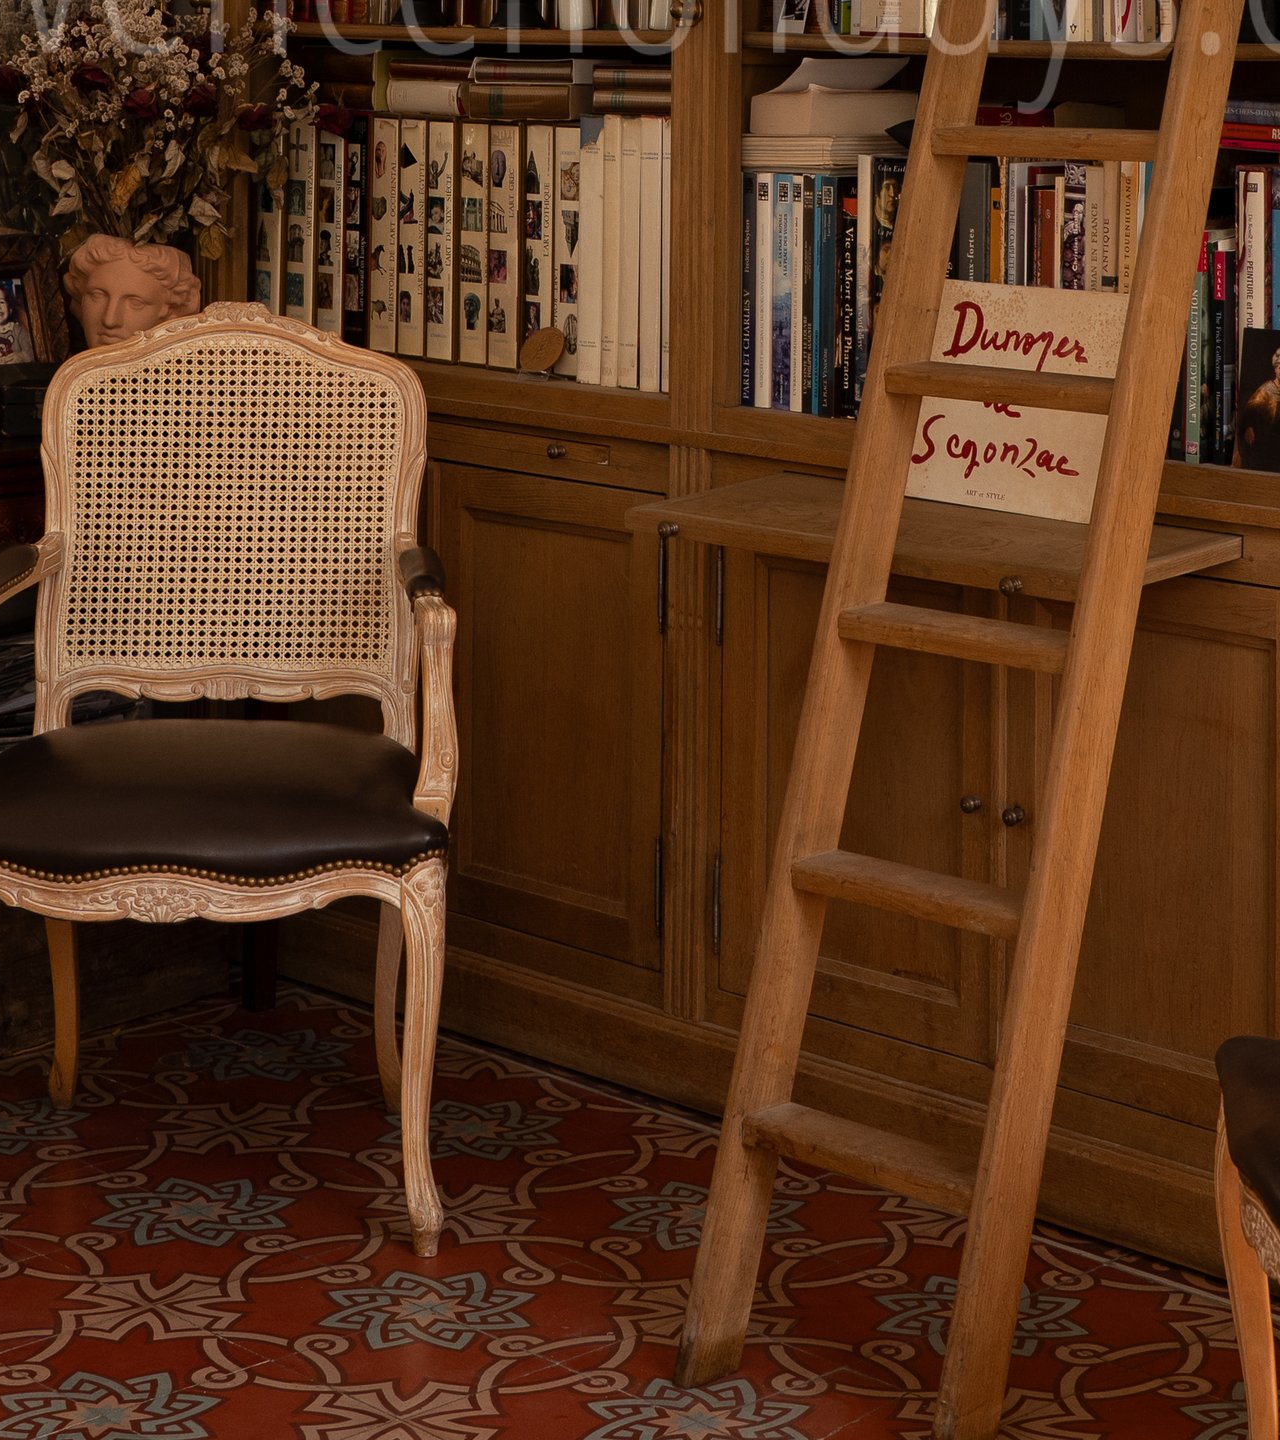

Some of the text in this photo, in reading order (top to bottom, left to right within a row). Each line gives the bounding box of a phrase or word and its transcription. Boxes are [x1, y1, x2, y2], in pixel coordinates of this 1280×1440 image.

[446, 230, 451, 242] DU
[1102, 218, 1110, 273] ANTIQUE
[843, 227, 853, 389] Vie Pharaon
[942, 301, 1088, 373] Dunoyer
[1189, 289, 1198, 357] COLLECTION
